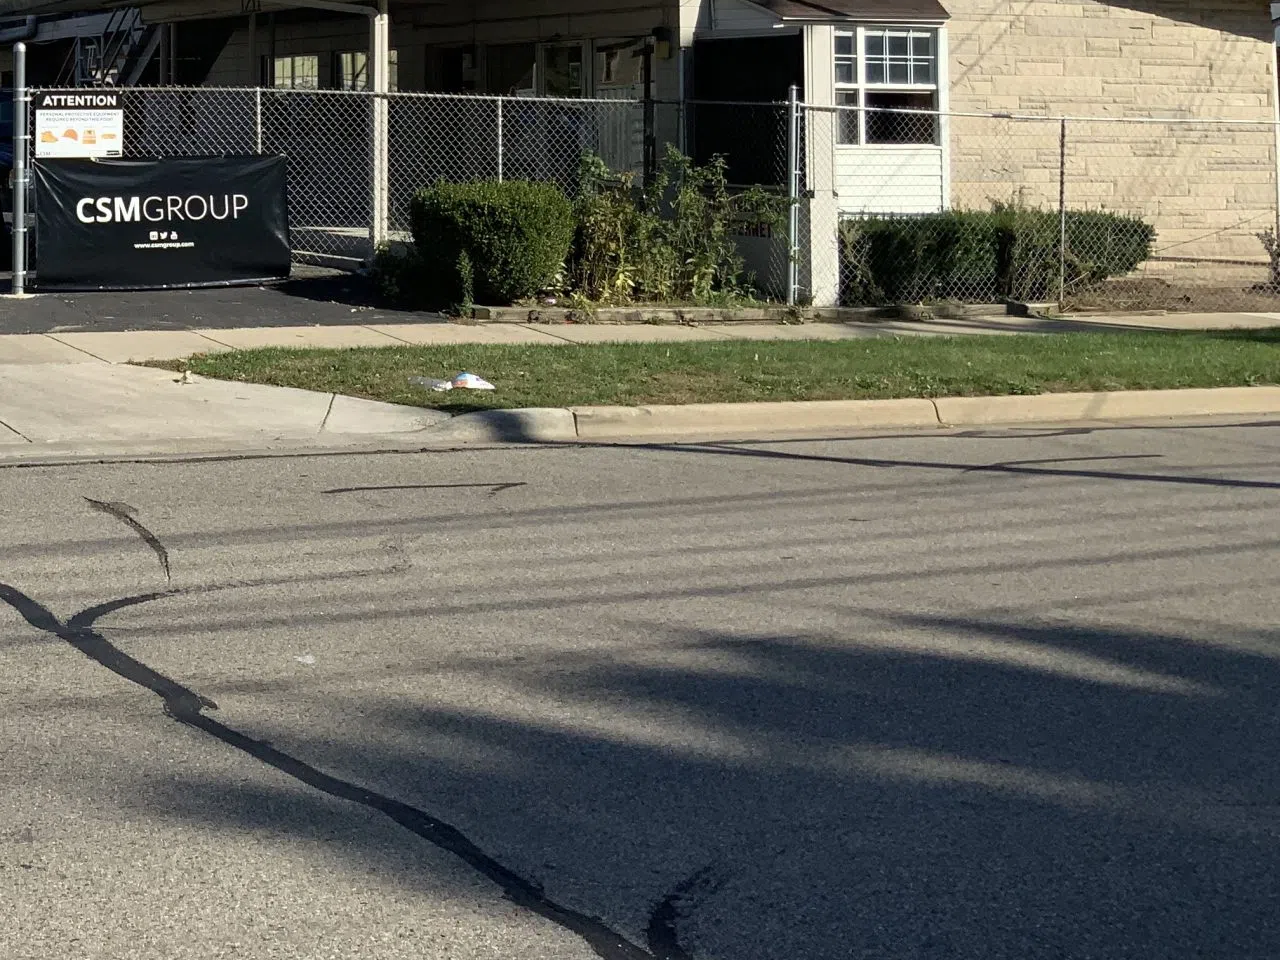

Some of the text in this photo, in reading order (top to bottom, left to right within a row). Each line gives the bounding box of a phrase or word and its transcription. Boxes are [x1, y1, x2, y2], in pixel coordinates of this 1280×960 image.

[42, 95, 117, 107] ATTENTION
[76, 194, 249, 224] CSMGROUP
[134, 241, 195, 249] www.csmgroup.com
